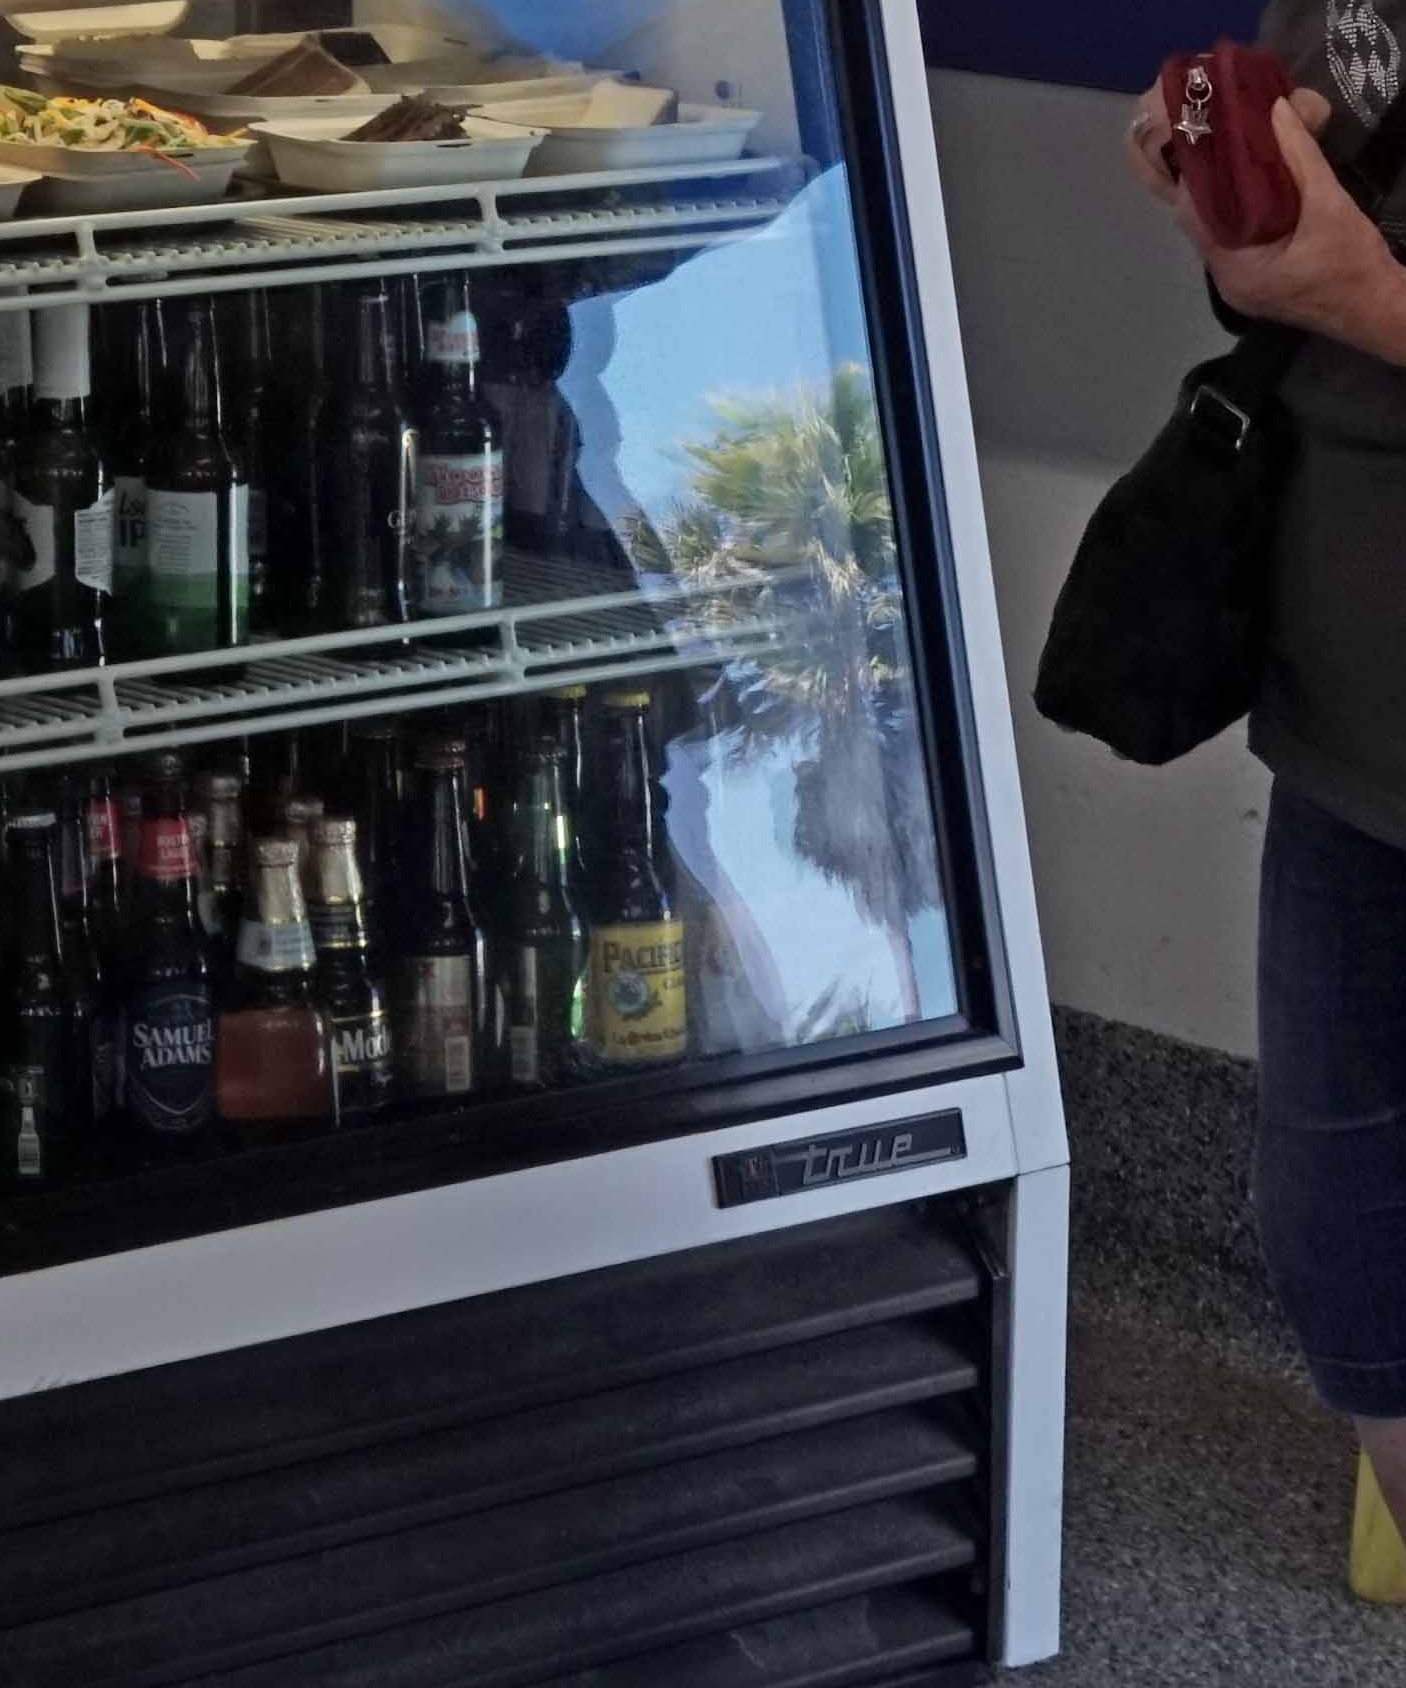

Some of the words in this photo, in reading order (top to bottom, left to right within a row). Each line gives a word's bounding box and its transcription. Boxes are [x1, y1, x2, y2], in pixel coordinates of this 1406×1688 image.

[602, 941, 682, 973] PACIFI
[133, 1019, 216, 1048] SAMUEL
[140, 1043, 213, 1067] ADAMS
[803, 1133, 913, 1185] true
